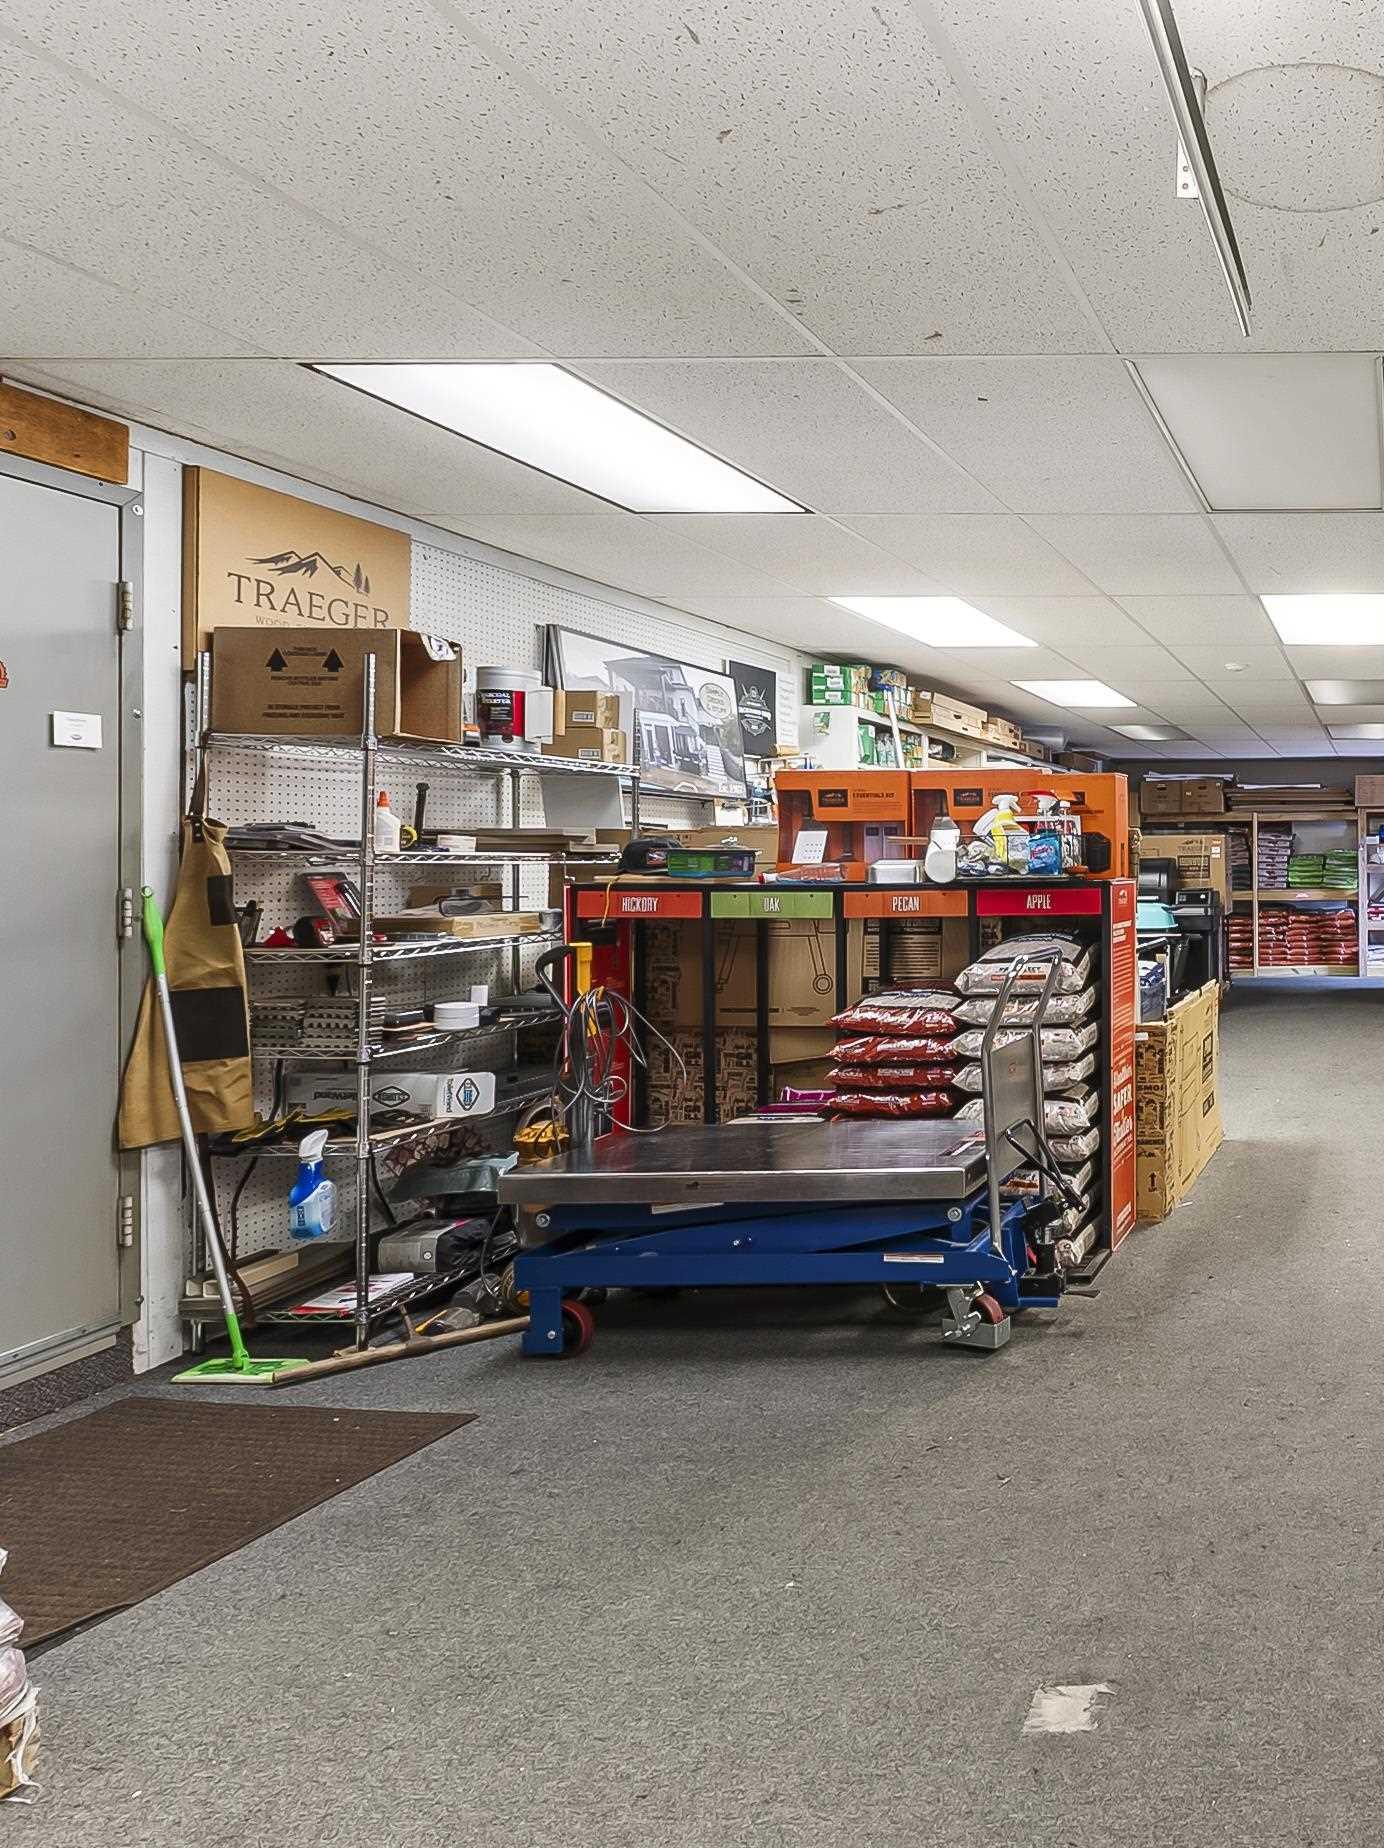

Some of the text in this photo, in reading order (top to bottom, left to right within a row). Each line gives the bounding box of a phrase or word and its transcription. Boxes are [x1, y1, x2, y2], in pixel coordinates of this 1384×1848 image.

[227, 572, 390, 629] TRAEGER
[622, 896, 660, 912] HICKORY
[763, 897, 781, 912] OAK
[892, 896, 920, 912] PECAN
[1026, 894, 1052, 910] APPLE
